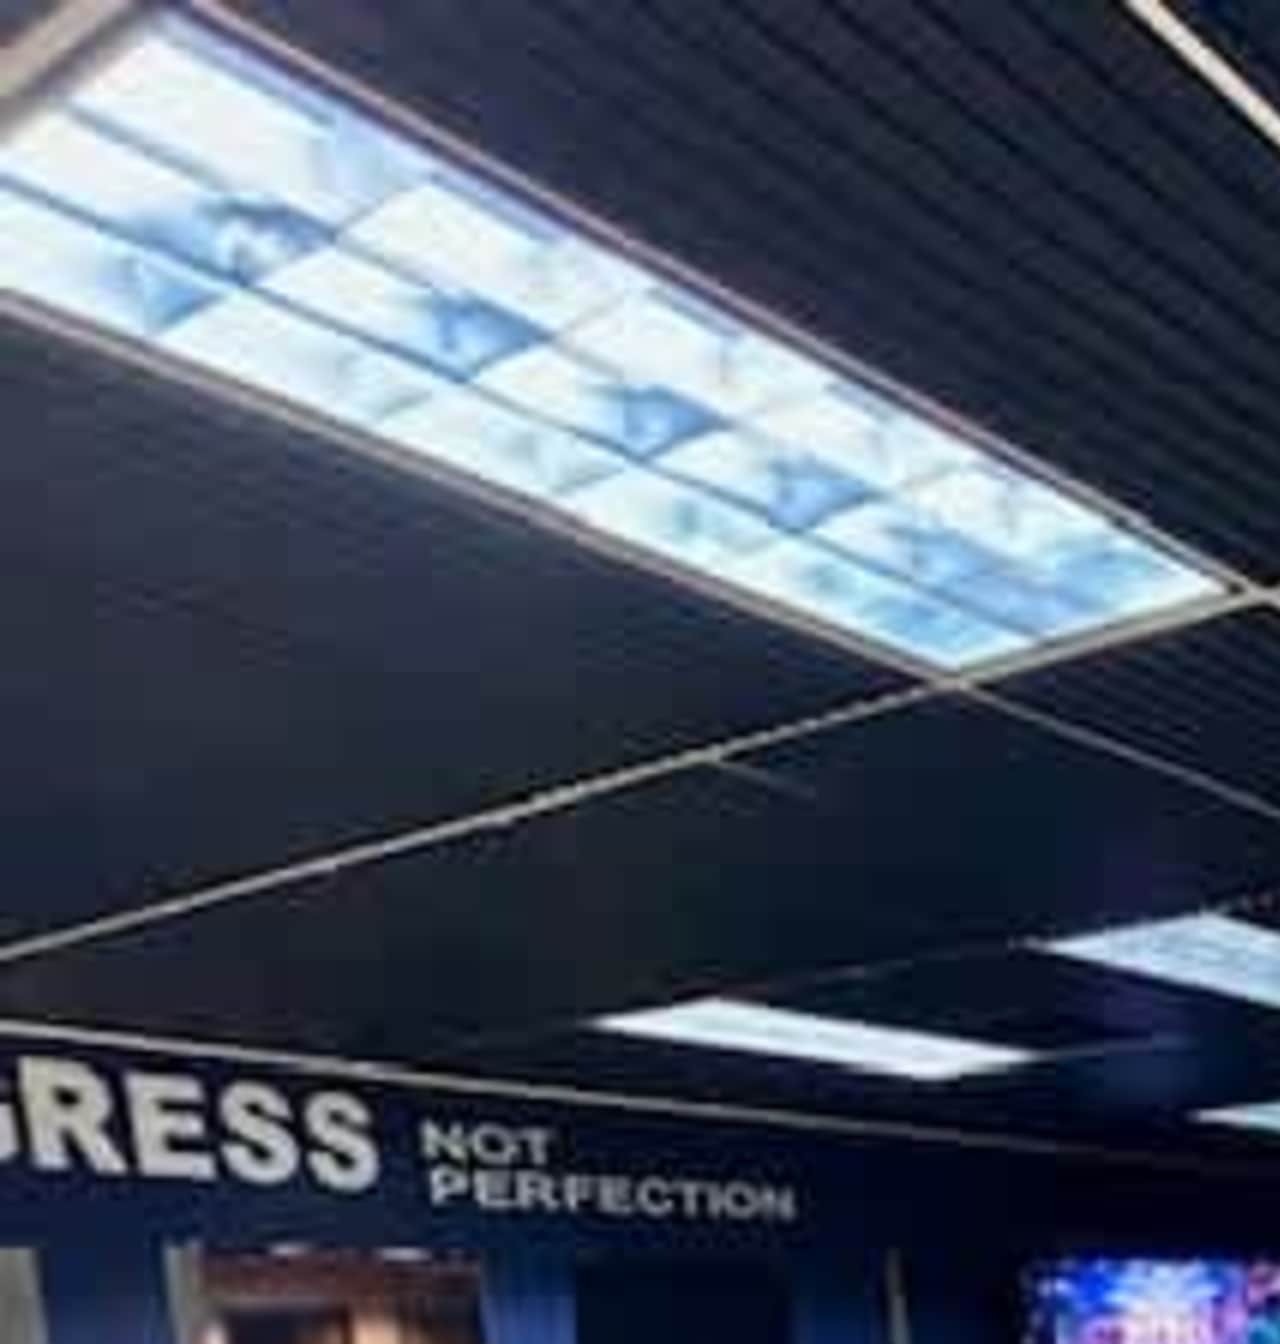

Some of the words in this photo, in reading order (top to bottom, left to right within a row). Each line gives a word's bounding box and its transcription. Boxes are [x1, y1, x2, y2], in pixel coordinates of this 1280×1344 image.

[0, 1056, 379, 1192] RESS
[419, 1118, 553, 1165] NOT
[430, 1163, 797, 1221] PERFECTION
